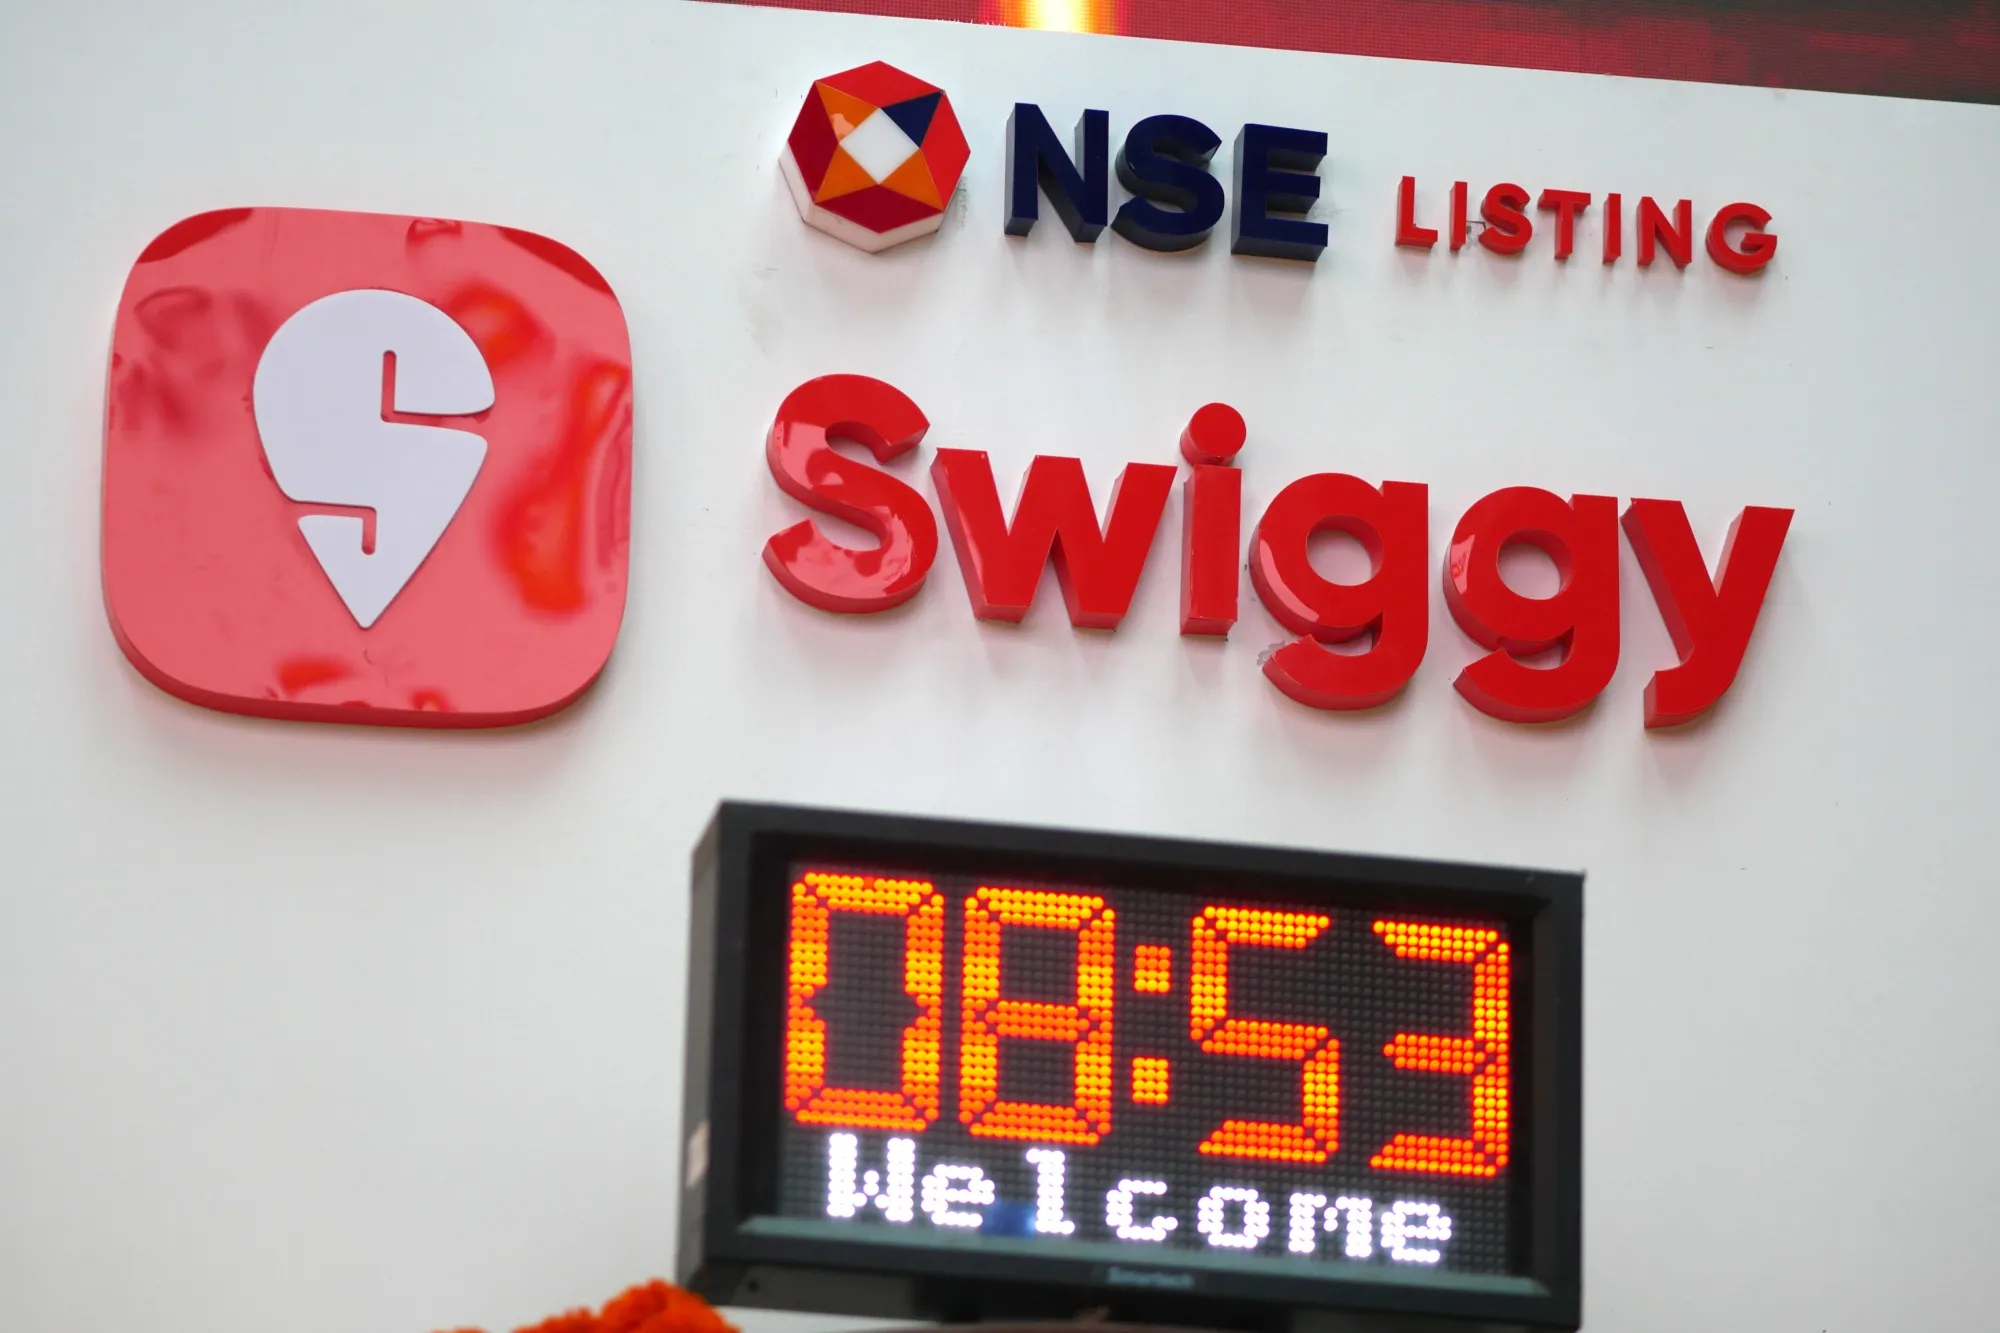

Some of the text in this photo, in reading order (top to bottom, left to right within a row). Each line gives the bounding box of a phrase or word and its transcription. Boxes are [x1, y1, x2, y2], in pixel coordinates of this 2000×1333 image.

[1004, 102, 1778, 275] NSE LISTING
[763, 373, 1795, 729] Swiggy
[784, 871, 1512, 1177] 08:53
[826, 1132, 1453, 1263] Welcome
